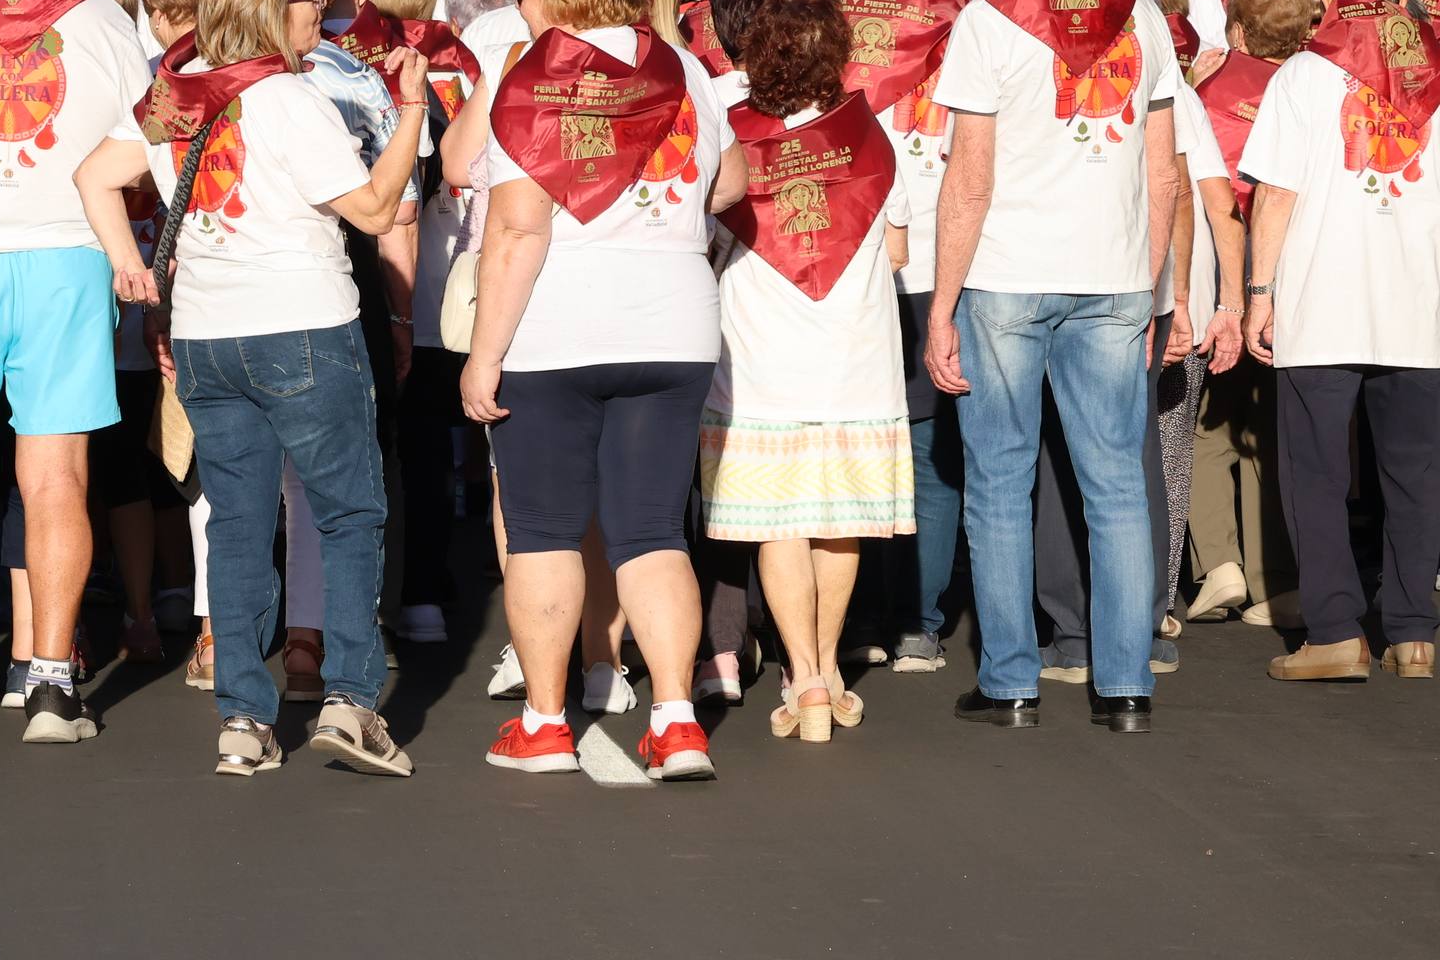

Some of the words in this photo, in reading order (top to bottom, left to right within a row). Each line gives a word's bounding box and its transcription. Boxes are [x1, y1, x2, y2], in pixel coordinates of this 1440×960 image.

[864, 0, 902, 10] FIESTAS
[907, 5, 920, 13] DE
[924, 10, 935, 18] LA
[1338, 3, 1366, 13] FERIA
[1341, 9, 1376, 19] VIRGEN
[892, 10, 934, 25] LORENZO
[341, 34, 357, 49] 25
[372, 46, 384, 55] DE
[1, 72, 23, 81] CON
[584, 70, 608, 81] 25
[1066, 62, 1131, 80] SLERA
[534, 86, 561, 94] FERIA
[567, 87, 573, 95] Y
[577, 87, 619, 96] FIESTAS
[534, 95, 569, 104] VIRGEN
[570, 96, 584, 105] DE
[586, 98, 606, 106] SAN
[609, 90, 646, 105] LORENZO
[780, 139, 802, 155] 25
[779, 155, 817, 170] FIESTAS
[823, 150, 836, 160] DE
[840, 146, 851, 155] LA
[773, 170, 786, 180] DE
[788, 166, 808, 176] SAN
[811, 155, 852, 171] LORENZO
